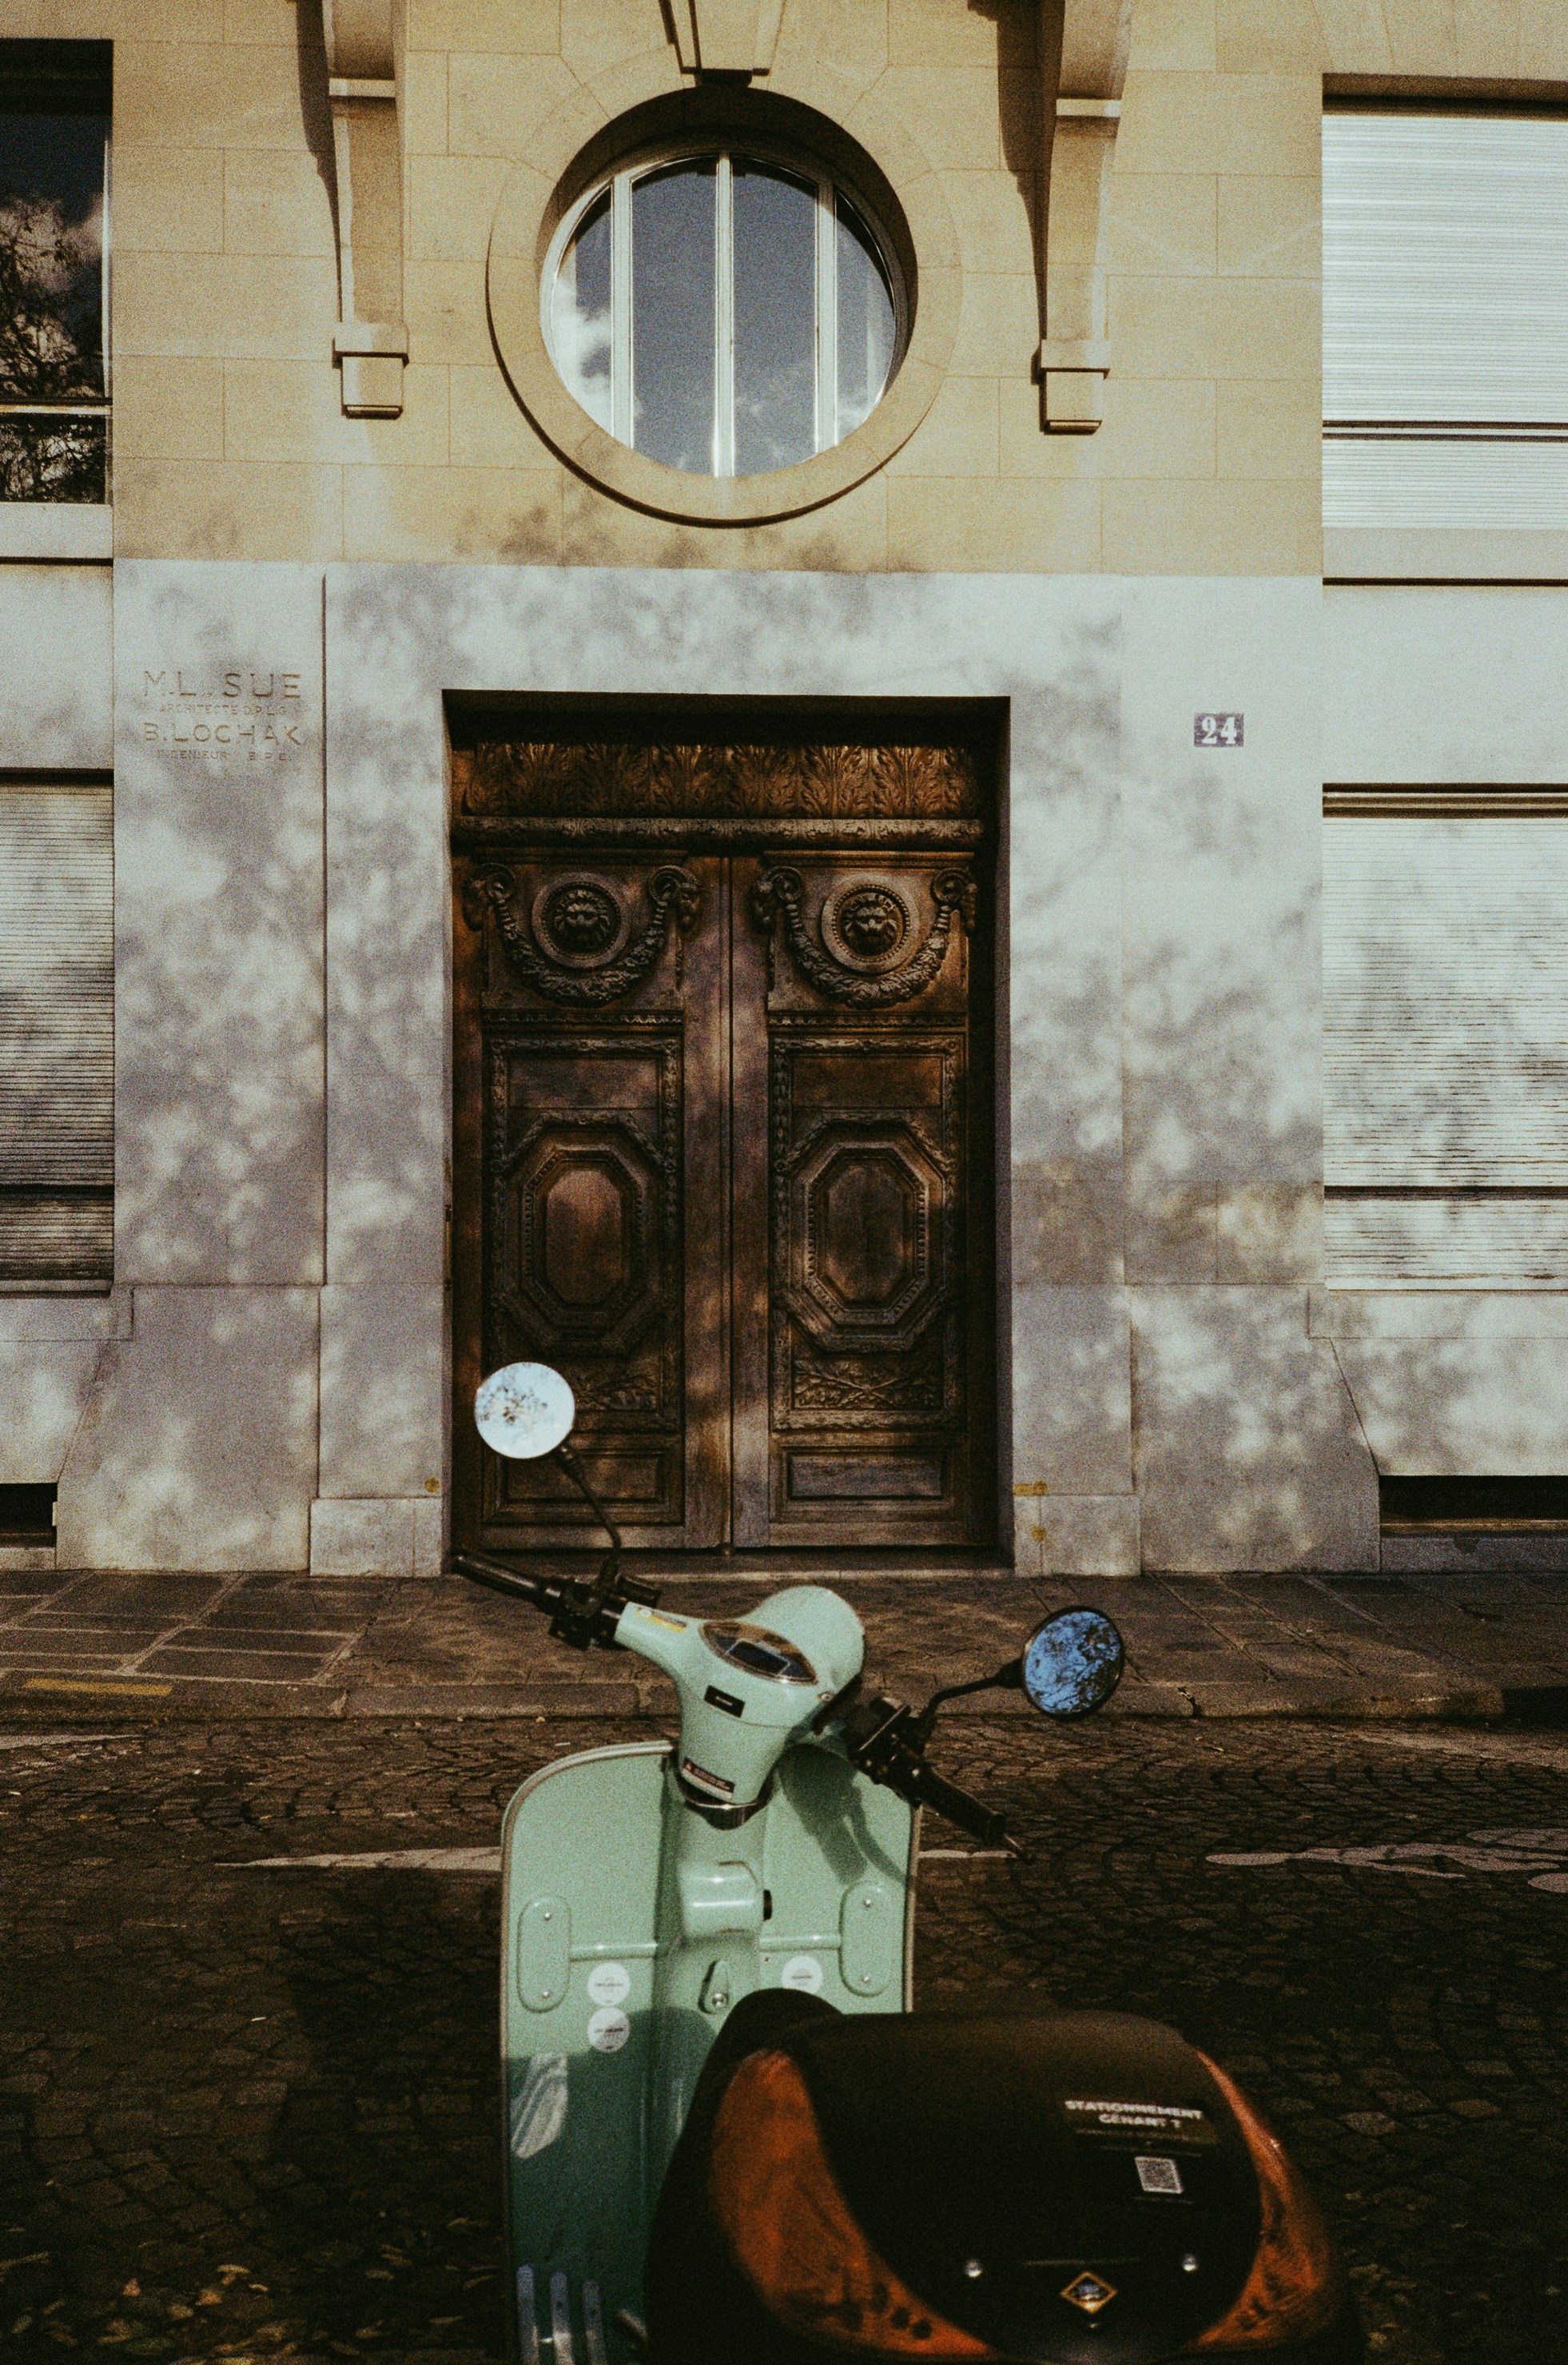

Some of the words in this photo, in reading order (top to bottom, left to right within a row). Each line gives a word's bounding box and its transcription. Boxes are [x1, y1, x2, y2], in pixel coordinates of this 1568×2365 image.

[221, 672, 302, 699] SUE
[1201, 716, 1238, 744] 24
[1064, 2100, 1204, 2120] STATIONNEMENT
